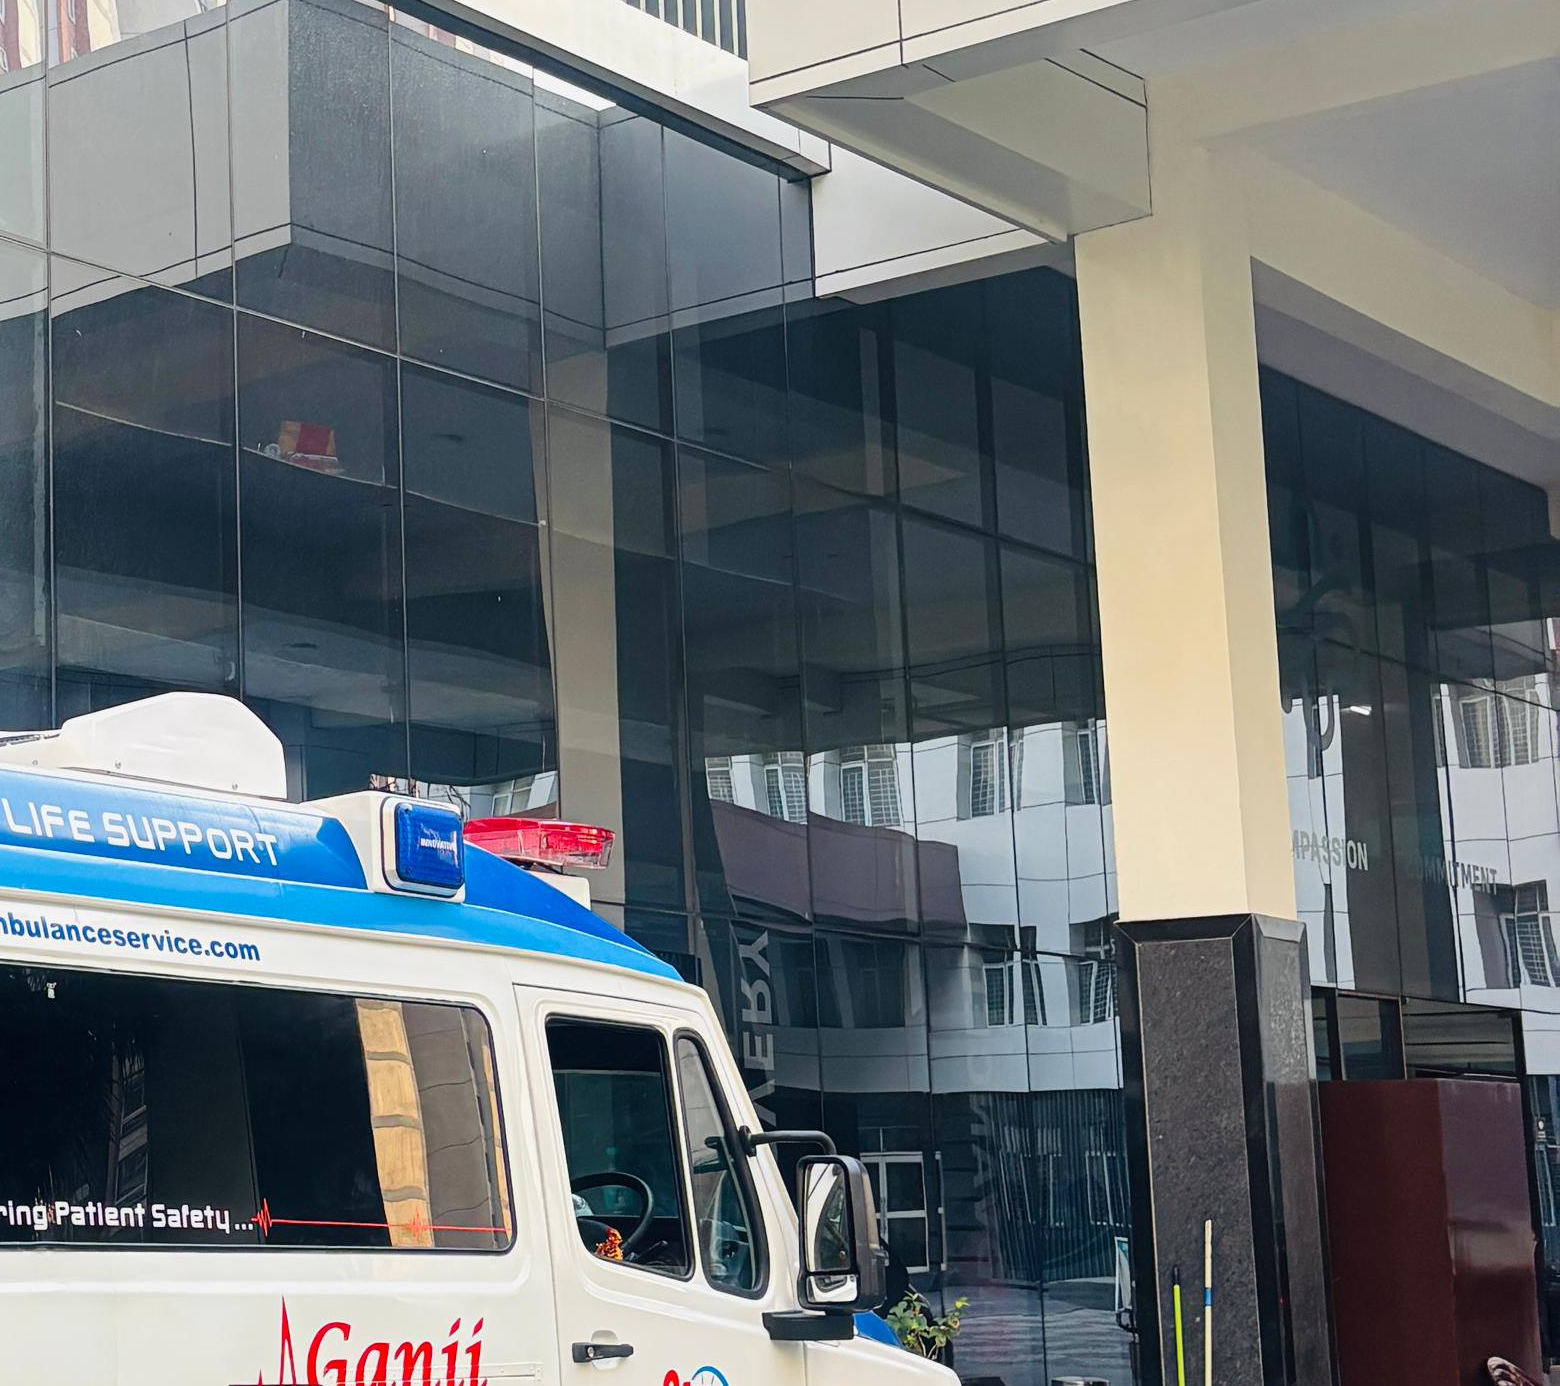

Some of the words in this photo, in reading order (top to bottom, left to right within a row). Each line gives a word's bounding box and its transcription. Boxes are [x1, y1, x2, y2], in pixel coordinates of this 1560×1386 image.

[1, 796, 95, 843] LIFE
[107, 818, 277, 867] SUPPORT
[56, 1201, 144, 1227] Patient
